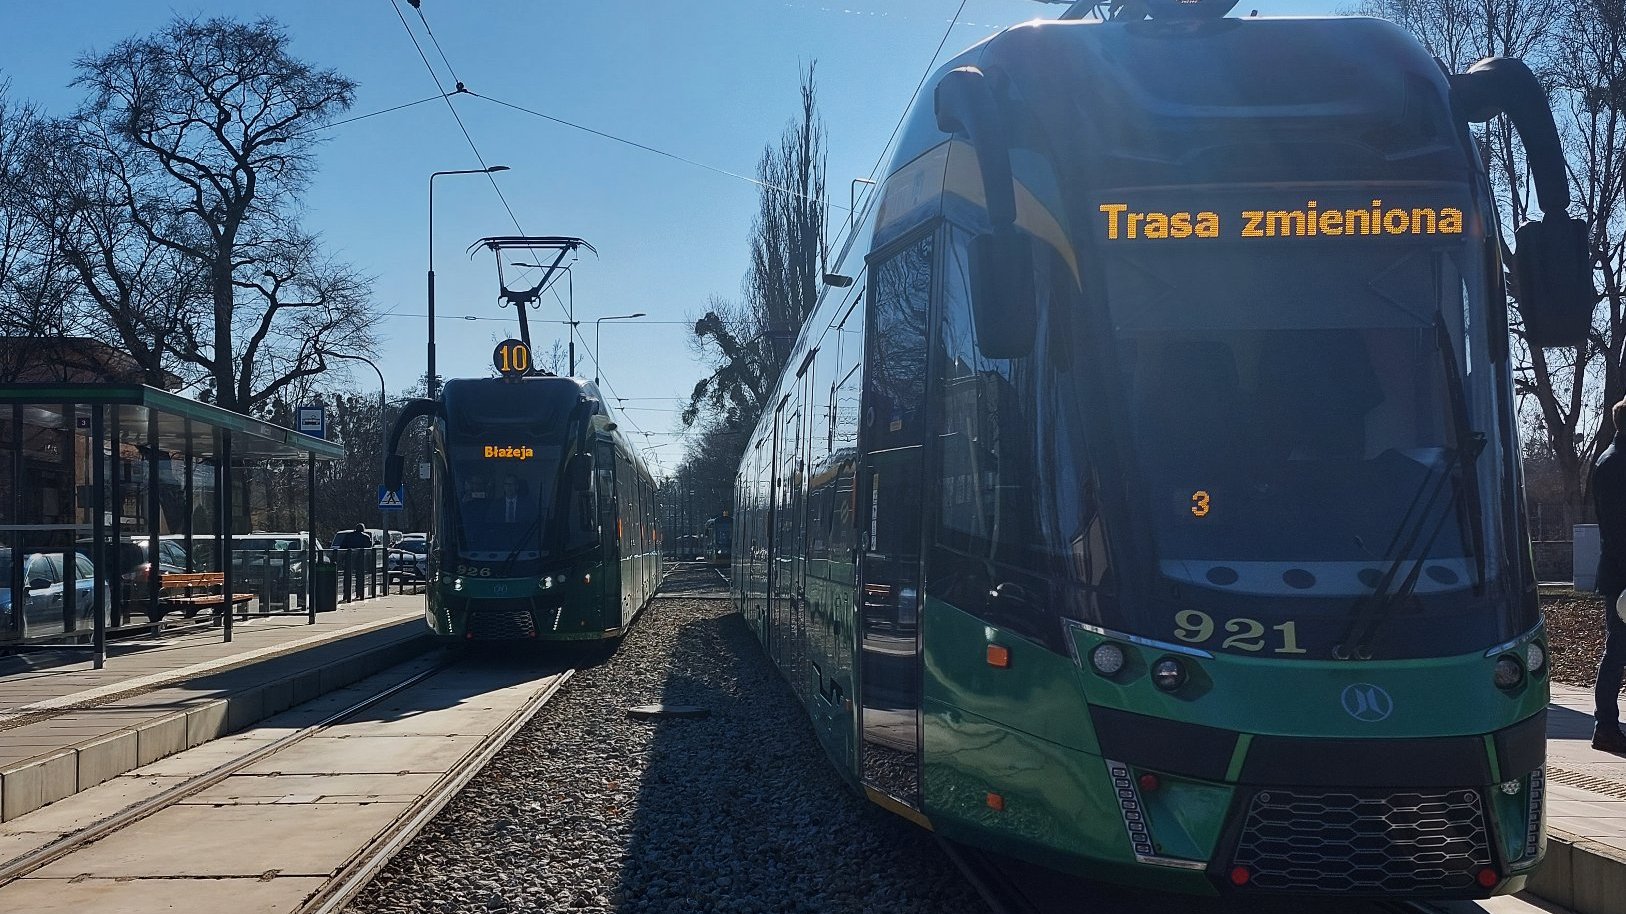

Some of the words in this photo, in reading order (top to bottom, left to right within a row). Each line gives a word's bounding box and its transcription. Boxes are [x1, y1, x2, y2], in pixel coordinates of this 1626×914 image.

[1099, 203, 1219, 240] Trasa
[1241, 199, 1463, 238] zmieniona
[499, 345, 527, 371] 10
[484, 445, 534, 460] Błażeja
[1191, 490, 1210, 517] 3
[456, 564, 491, 577] 926
[1173, 609, 1307, 654] 921
